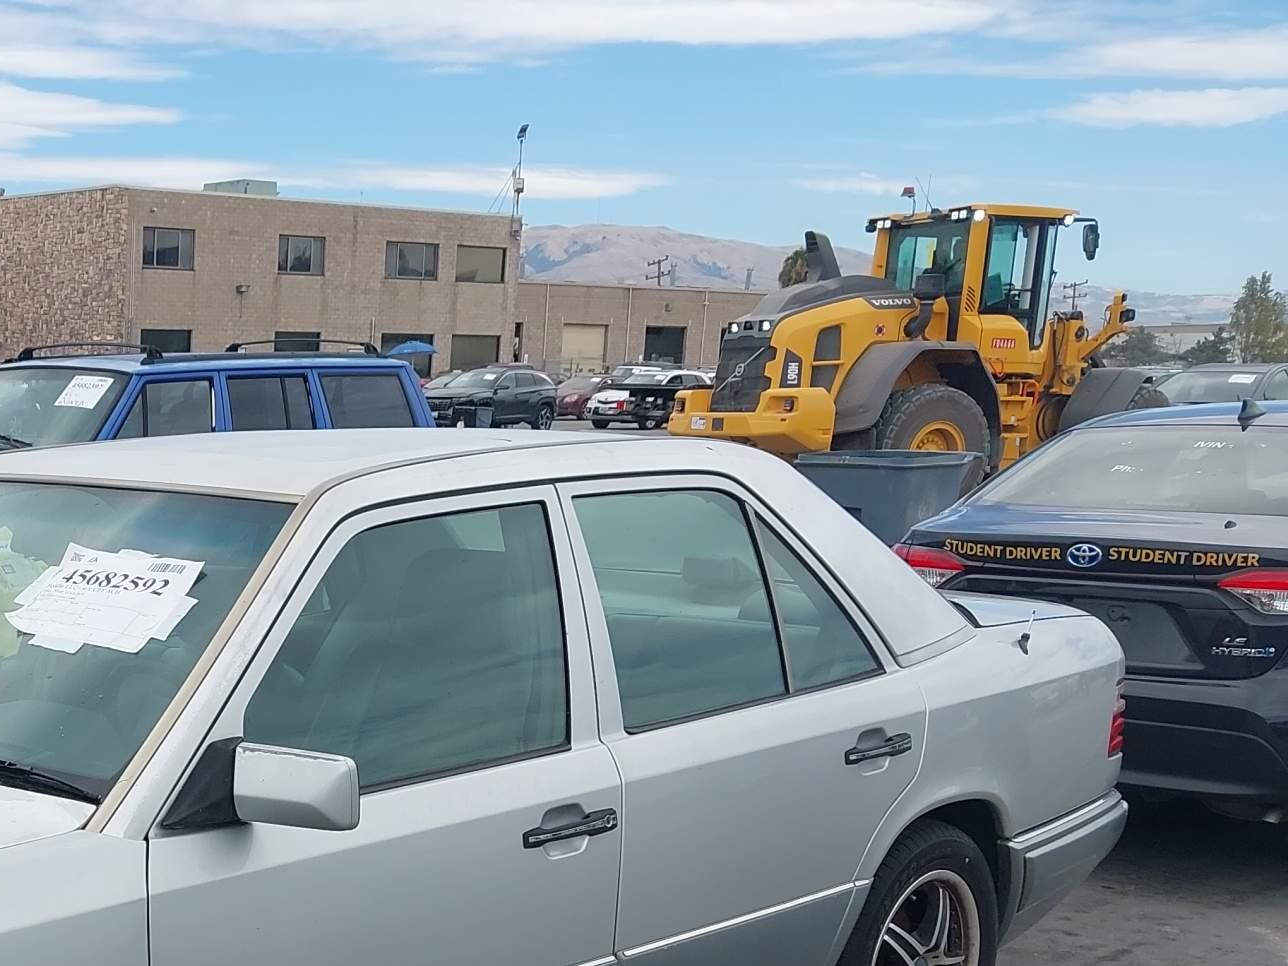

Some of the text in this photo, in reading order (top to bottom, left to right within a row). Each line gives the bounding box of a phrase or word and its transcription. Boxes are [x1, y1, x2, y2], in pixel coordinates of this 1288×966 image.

[871, 298, 912, 306] VOLVO
[787, 362, 800, 385] L90H
[943, 538, 1061, 561] STUDENT DRIVER
[1108, 546, 1260, 567] STUDENT DRIVER
[62, 568, 170, 597] 45682592
[1211, 646, 1265, 657] HYBRID
[1222, 637, 1248, 646] LE
